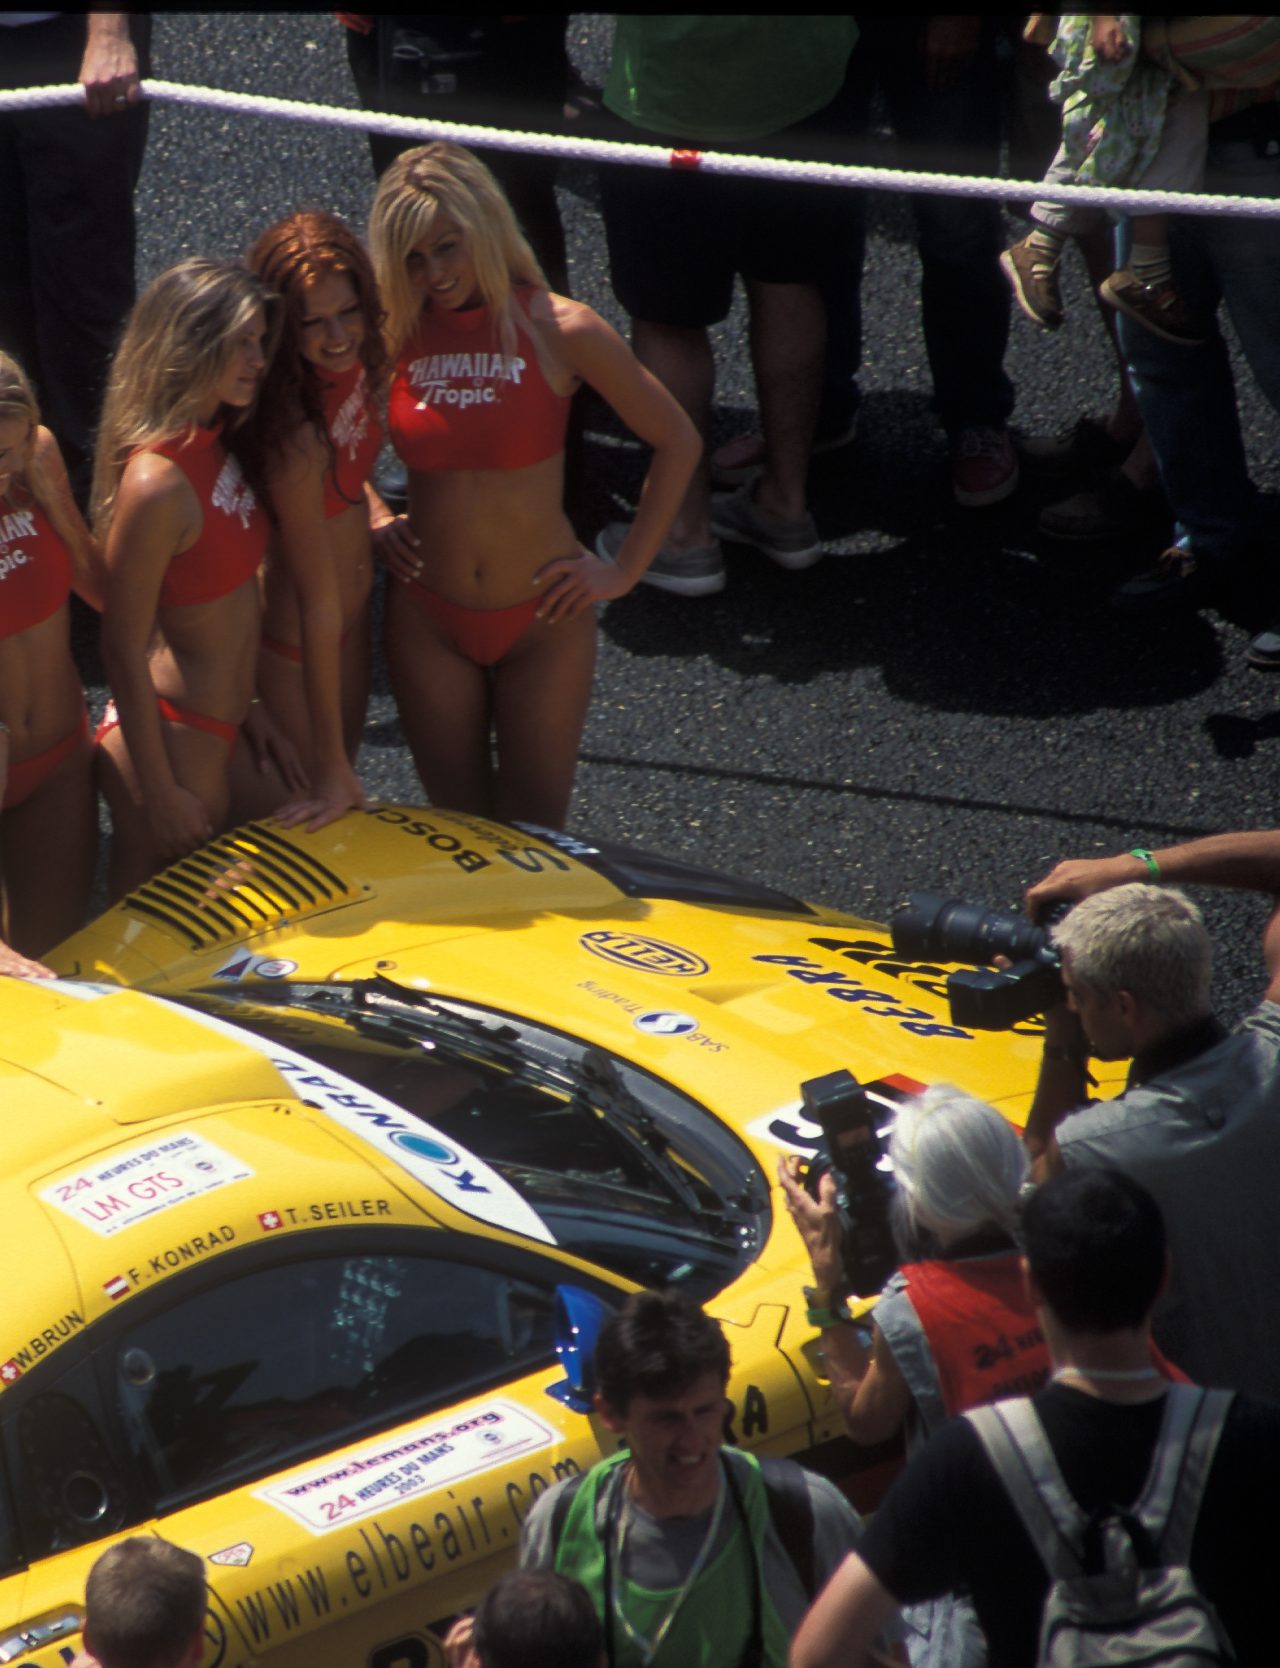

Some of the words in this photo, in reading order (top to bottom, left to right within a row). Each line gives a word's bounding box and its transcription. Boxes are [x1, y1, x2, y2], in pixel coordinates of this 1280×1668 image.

[407, 352, 527, 385] HAWAIIAN
[414, 379, 497, 410] Tropic
[582, 930, 697, 974] HELLA
[750, 954, 975, 1041] BEBRA
[55, 1176, 94, 1202] 24
[80, 1194, 132, 1222] LM
[127, 1171, 184, 1200] GTS
[285, 1410, 503, 1497] www.lemans.org
[319, 1493, 358, 1521] 24
[355, 1471, 403, 1501] HEURES
[399, 1460, 420, 1476] DU
[419, 1442, 456, 1466] MANS
[396, 1473, 427, 1495] 2003
